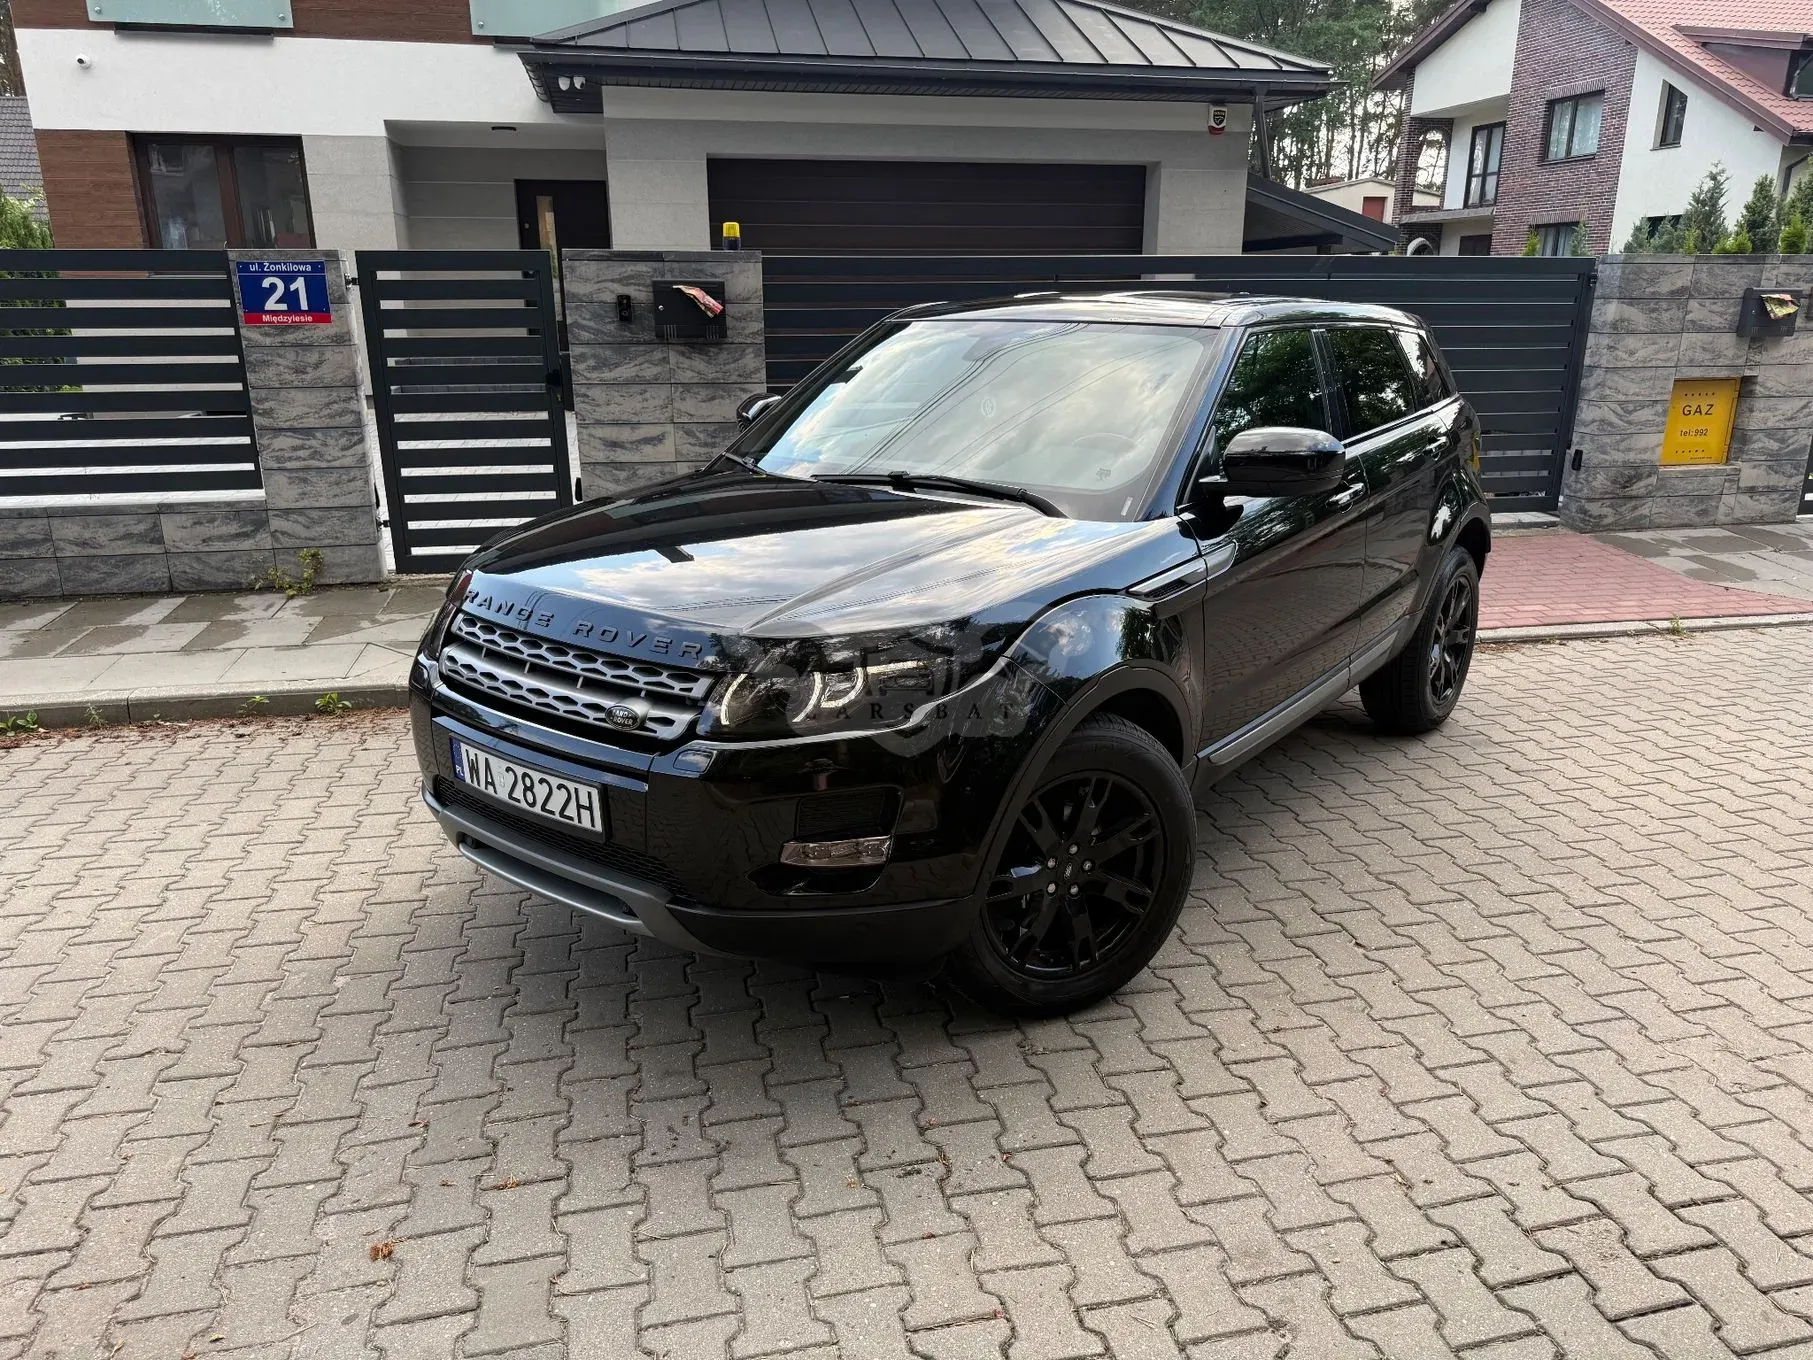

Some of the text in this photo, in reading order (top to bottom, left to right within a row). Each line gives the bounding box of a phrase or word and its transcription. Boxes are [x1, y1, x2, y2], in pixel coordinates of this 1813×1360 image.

[249, 261, 312, 272] ul. Żonkilowa
[261, 276, 309, 311] 21
[262, 314, 313, 324] Międzylesie
[1682, 403, 1715, 416] GAZ
[1680, 427, 1709, 437] tel:992
[463, 589, 703, 661] RANGE ROVER
[612, 716, 633, 725] ROVER
[455, 764, 464, 777] PL
[465, 748, 596, 828] WA 2822H
